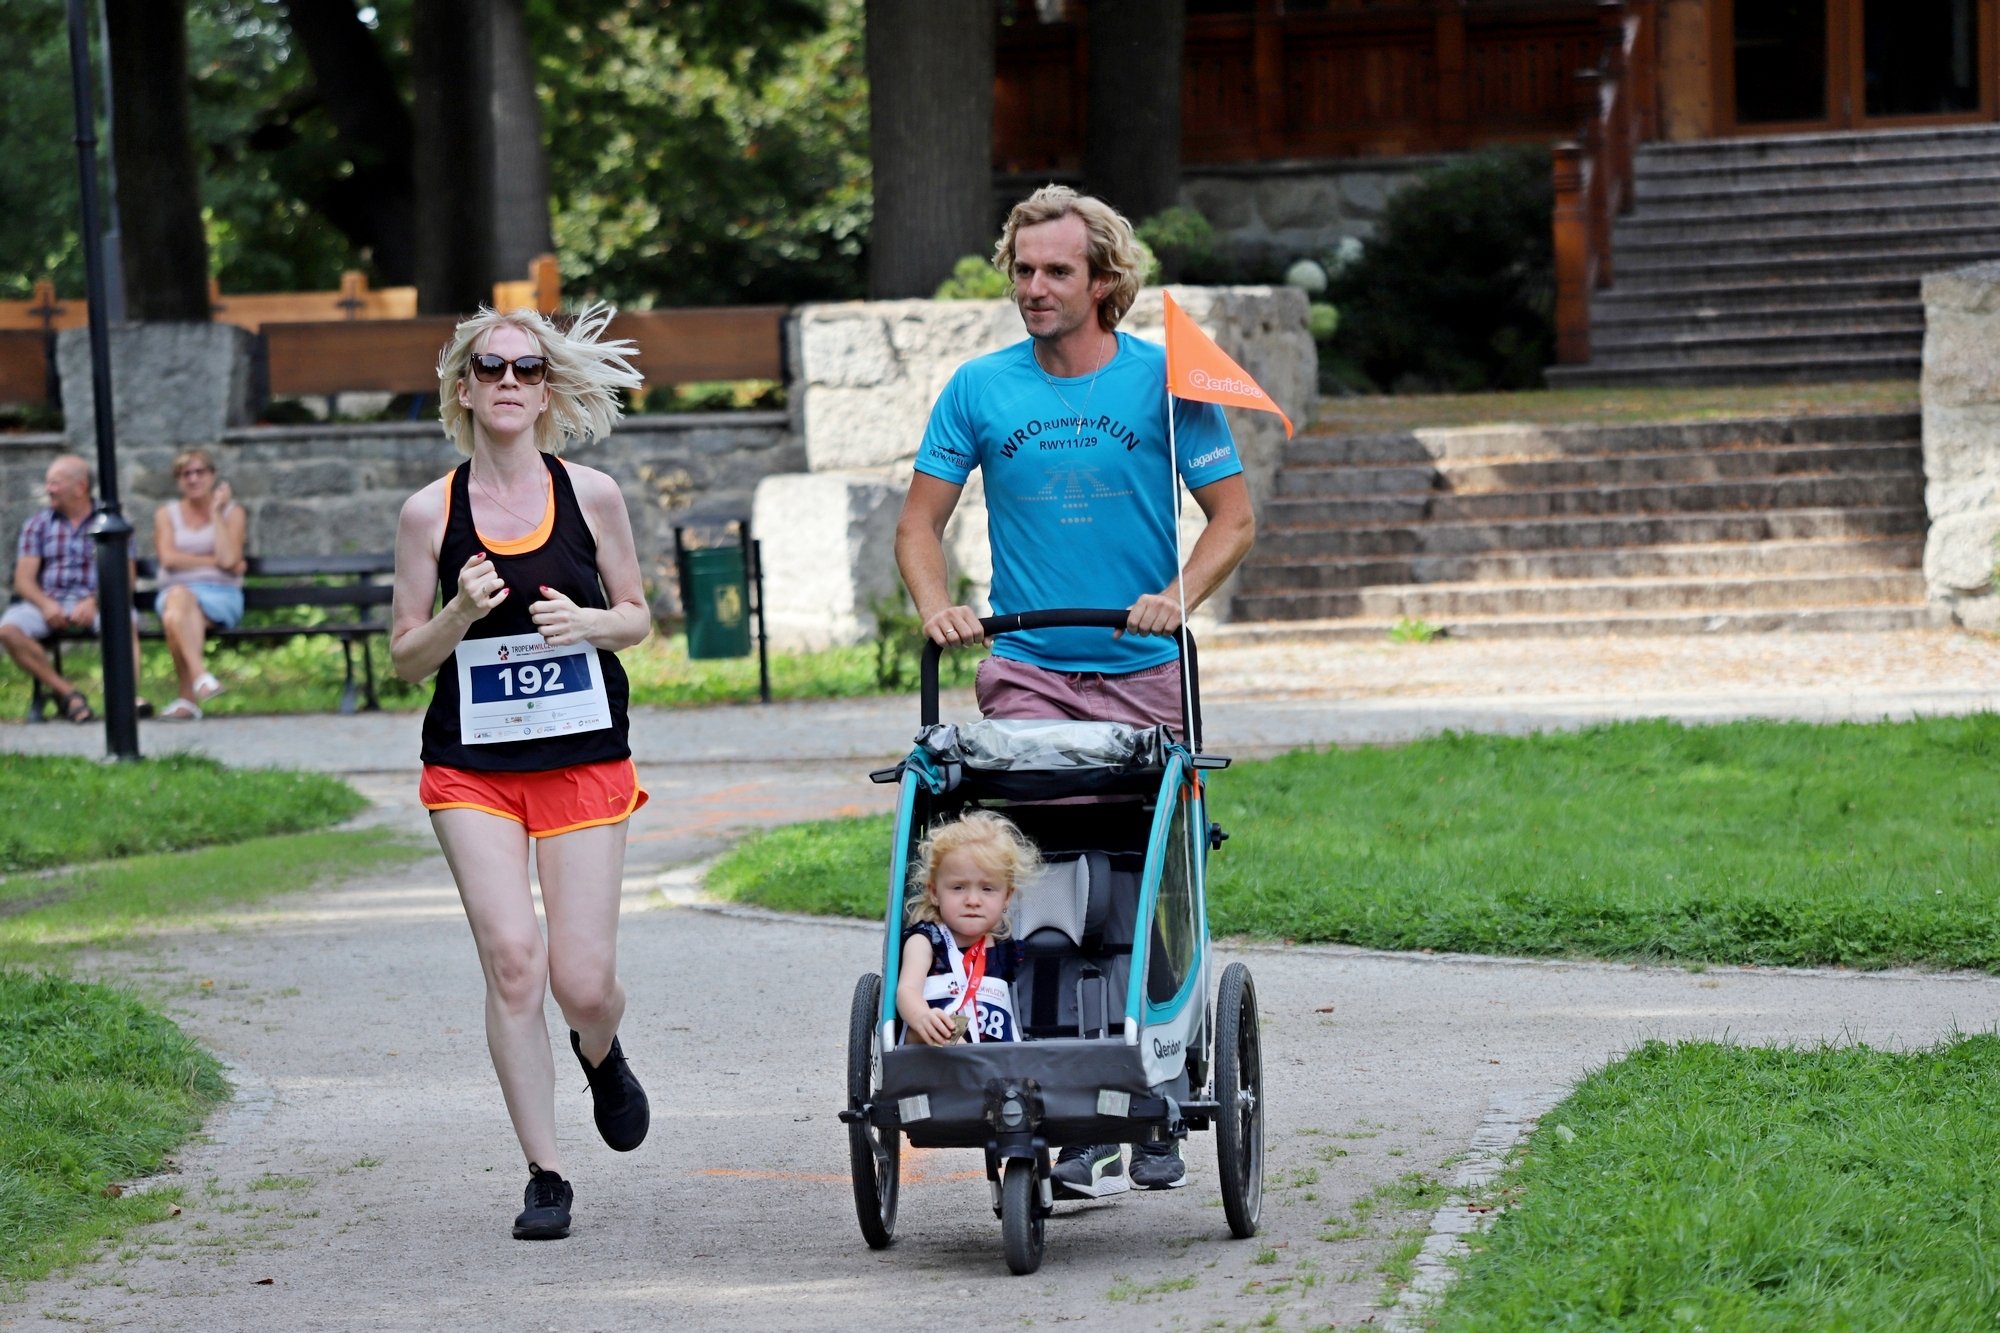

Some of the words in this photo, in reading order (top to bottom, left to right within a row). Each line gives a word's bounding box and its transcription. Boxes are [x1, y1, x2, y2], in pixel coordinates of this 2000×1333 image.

[1189, 369, 1263, 398] Qeridoo
[1039, 437, 1098, 451] RWY11/29
[1188, 446, 1231, 468] Lagardere
[498, 662, 565, 696] 192
